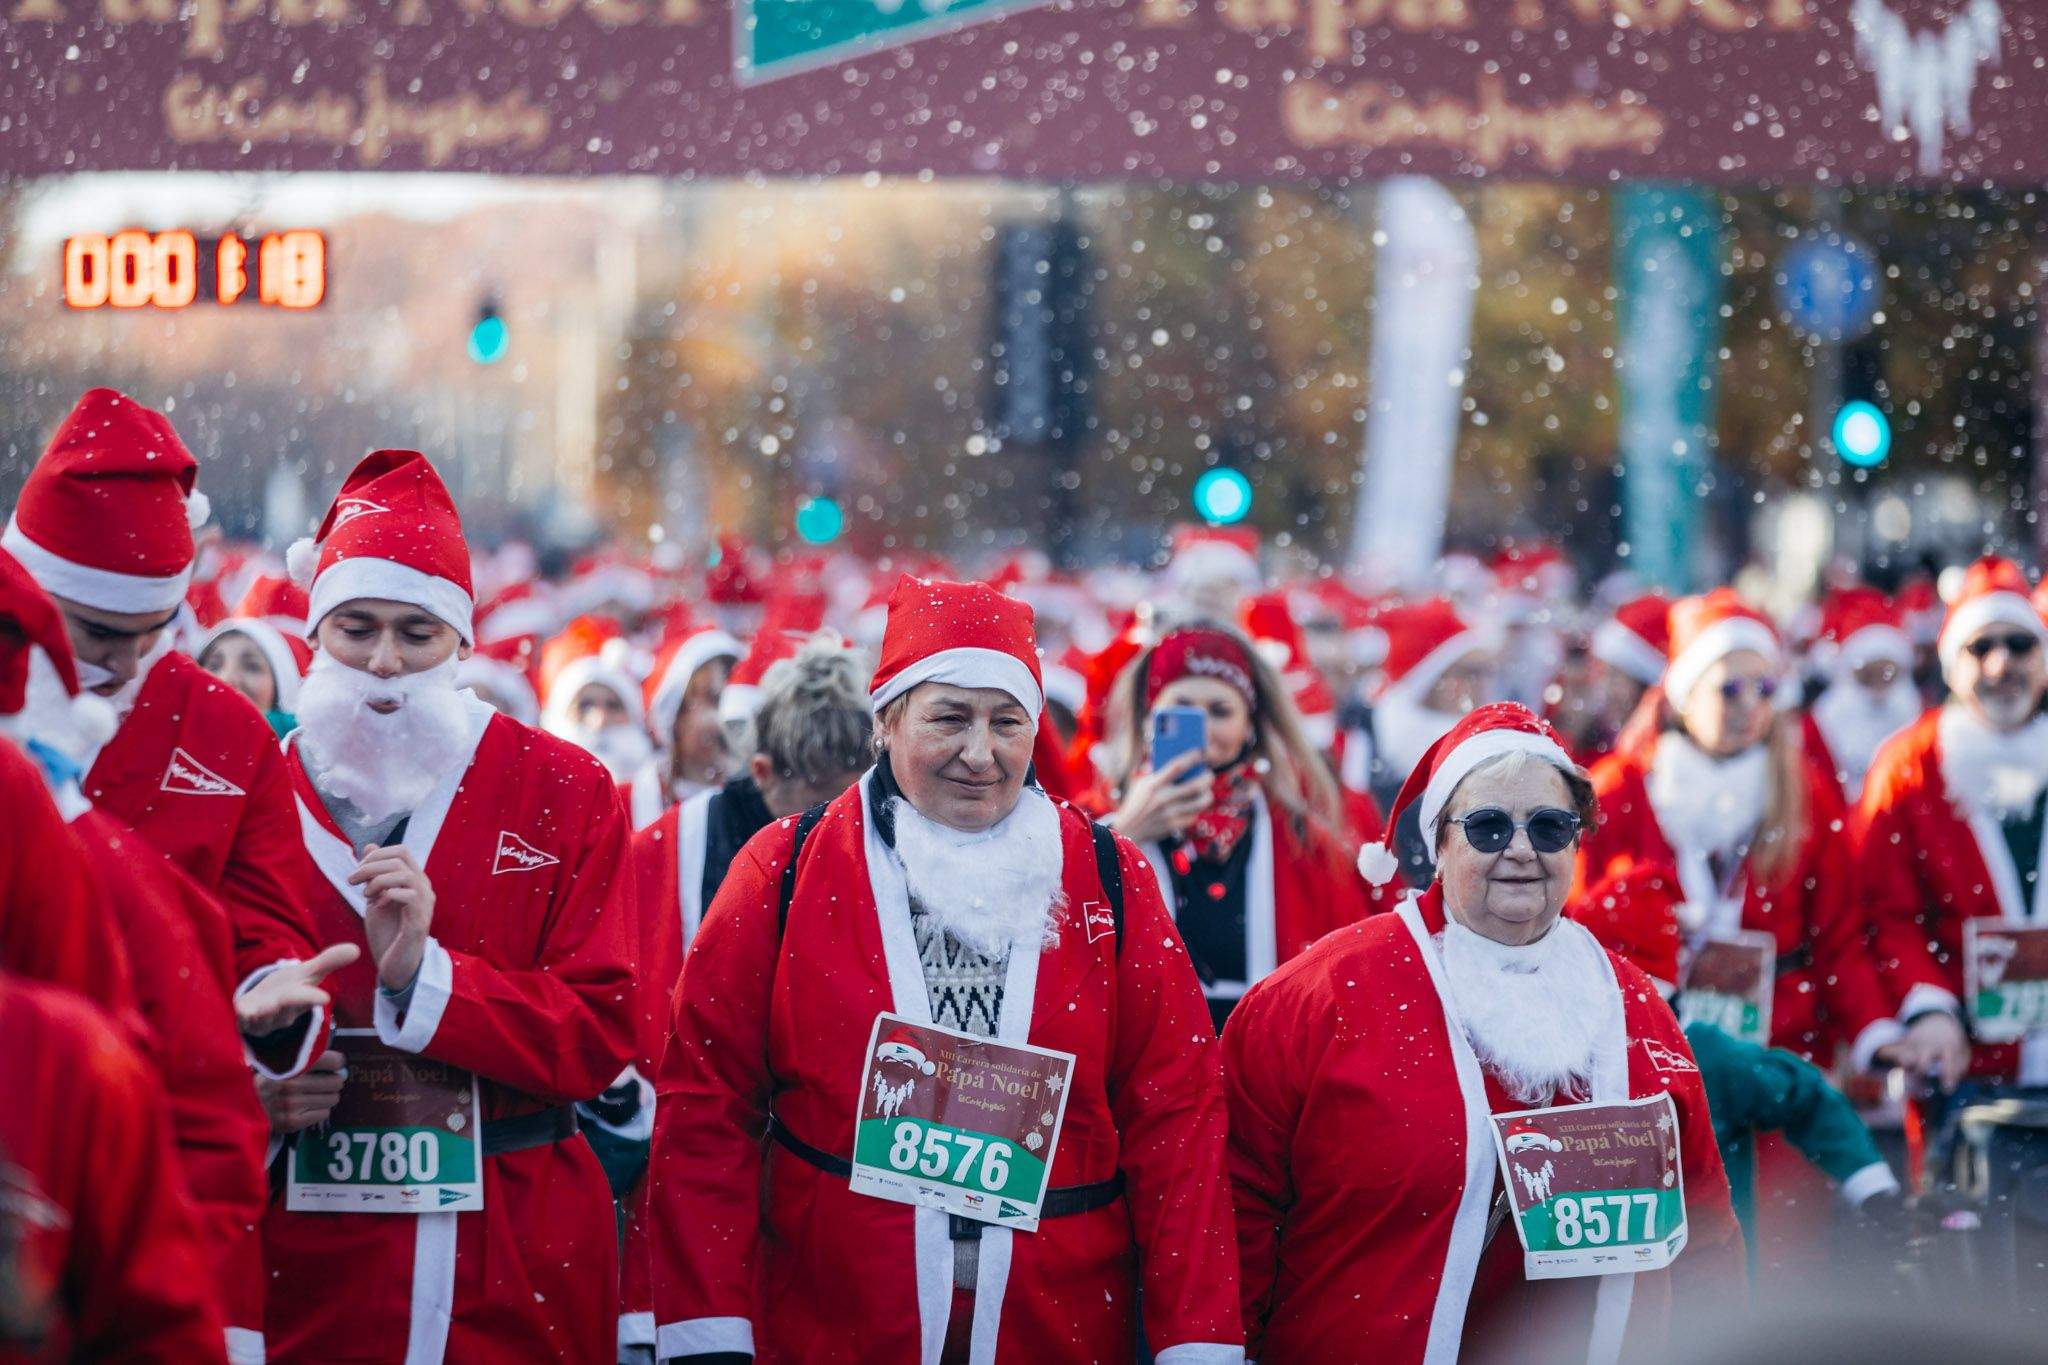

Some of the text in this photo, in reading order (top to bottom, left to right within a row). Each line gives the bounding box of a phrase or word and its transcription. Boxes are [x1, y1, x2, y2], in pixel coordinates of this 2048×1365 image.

[935, 1061, 1040, 1101] Papá Noel
[957, 1054, 990, 1069] Carrera
[991, 1063, 1029, 1077] solidaria
[1031, 1070, 1042, 1079] de
[327, 1131, 440, 1182] 3780
[889, 1122, 1013, 1192] 8576
[1561, 1130, 1657, 1155] Papá Noel
[1554, 1193, 1659, 1247] 8577
